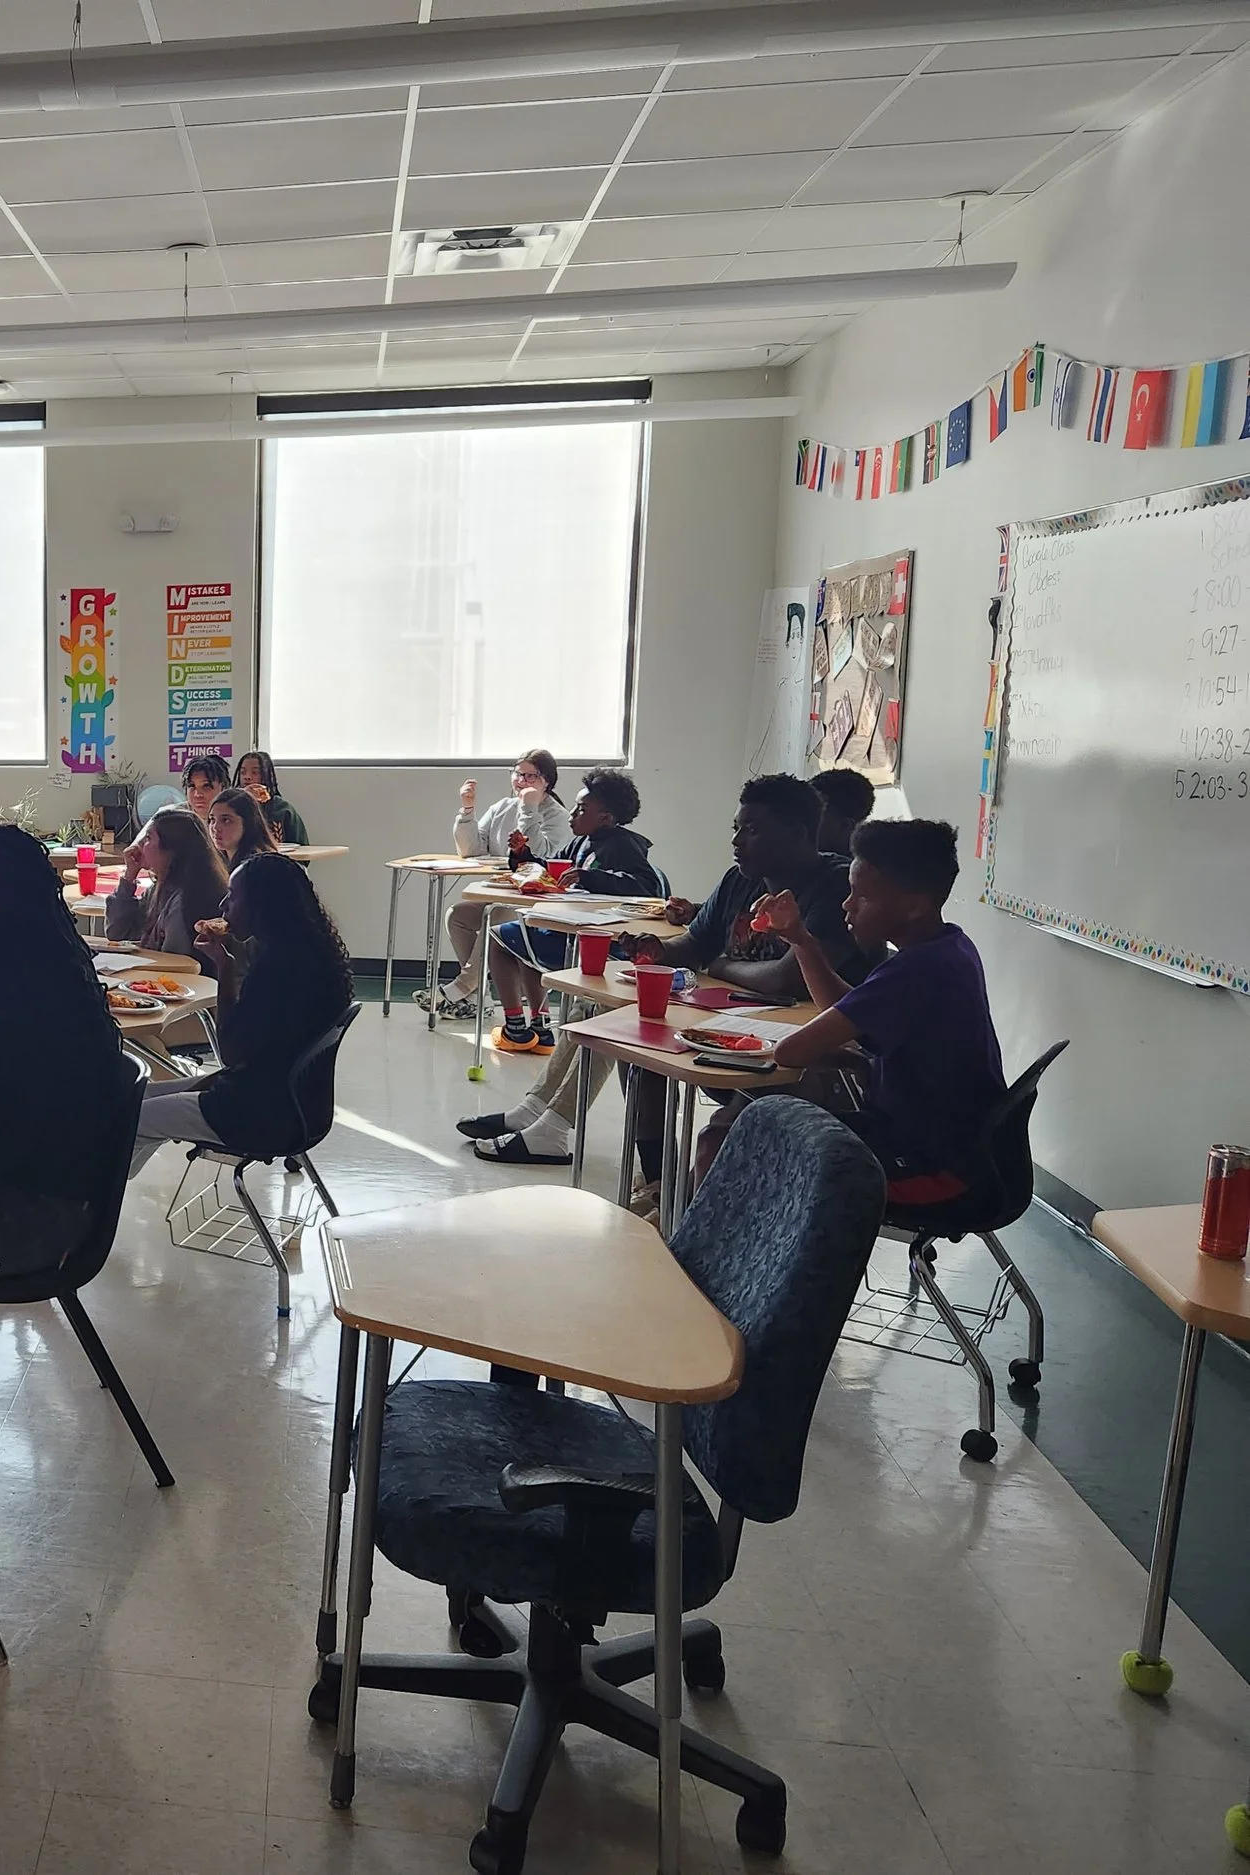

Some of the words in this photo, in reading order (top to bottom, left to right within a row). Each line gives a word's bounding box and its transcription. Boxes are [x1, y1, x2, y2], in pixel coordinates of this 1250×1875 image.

[1051, 538, 1075, 562] Class
[170, 586, 226, 606] MISTAKES
[173, 614, 230, 634] IMPROVEMENT
[171, 639, 211, 658] NEVER
[78, 594, 98, 765] GROWTH
[171, 665, 230, 684] DETERMINATION
[171, 691, 221, 710] SUCCESS
[172, 719, 219, 738] EFFORT
[173, 747, 221, 766] THINGS
[1175, 769, 1186, 799] 5
